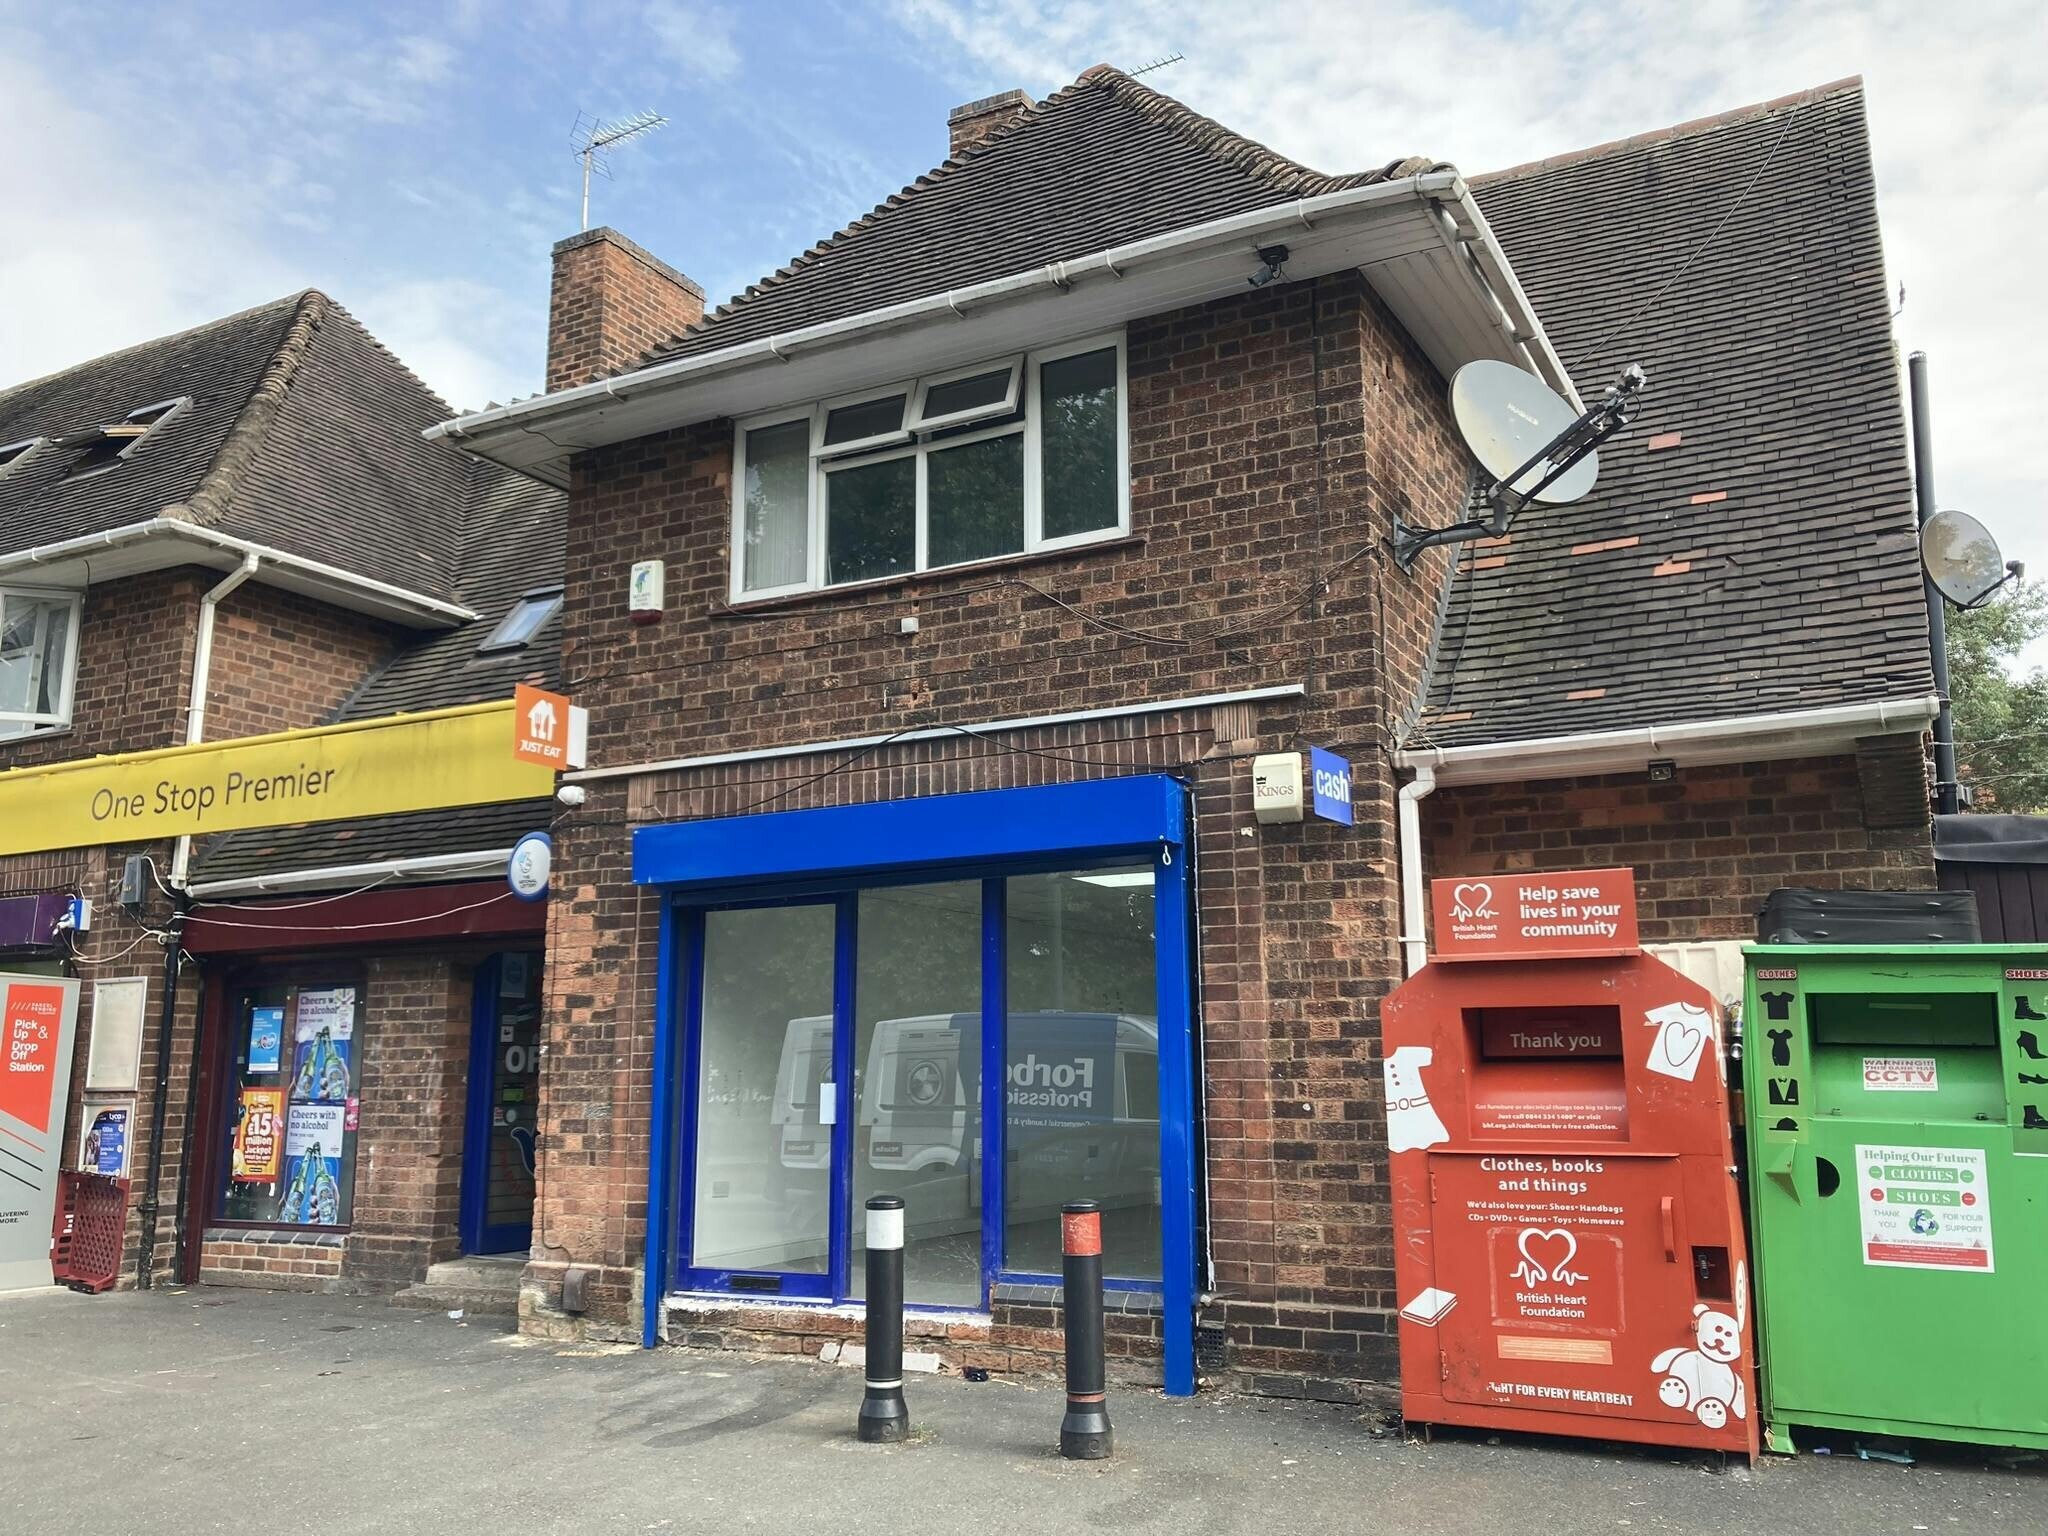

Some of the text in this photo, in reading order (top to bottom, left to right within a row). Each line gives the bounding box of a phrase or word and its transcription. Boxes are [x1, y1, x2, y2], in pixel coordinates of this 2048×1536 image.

[520, 739, 562, 759] JUST EAT
[92, 763, 335, 821] One Stop Premier
[1257, 784, 1294, 797] KINGS
[1316, 769, 1349, 803] cash
[1519, 886, 1599, 903] Help save
[1520, 903, 1621, 920] lives in your
[1452, 924, 1475, 932] British
[1521, 920, 1617, 938] community
[1455, 932, 1496, 940] Foundation
[1758, 970, 1796, 978] CLOTHES
[2006, 970, 2048, 978] SHOES
[15, 1019, 37, 1029] Pick
[14, 1026, 48, 1040] Up &
[12, 1041, 38, 1053] Drop
[1510, 1032, 1601, 1051] Thank you
[11, 1051, 28, 1060] Off
[9, 1062, 45, 1072] Station
[1865, 1070, 1934, 1082] CCTV
[291, 1110, 336, 1119] Cheers with
[247, 1113, 273, 1136] £15
[301, 1120, 328, 1130] alcohol
[245, 1136, 273, 1146] million
[1864, 1150, 1977, 1164] Helping Our Future
[1480, 1158, 1603, 1174] Clothes, books
[1891, 1169, 1954, 1180] CLOTHES
[1498, 1178, 1587, 1195] and things
[1896, 1191, 1951, 1203] SHOES
[1467, 1201, 1486, 1209] We'd
[1488, 1201, 1505, 1209] also
[1580, 1204, 1624, 1214] Handbags
[1873, 1209, 1900, 1217] THANK
[1468, 1213, 1624, 1225] CDs DVDs Games Toys Homeware
[1943, 1213, 1983, 1222] FOR YOUR
[1945, 1225, 1983, 1233] SUPPORT
[1516, 1292, 1587, 1305] British Heart
[1520, 1306, 1585, 1318] Foundation
[1516, 1384, 1535, 1396] FOR
[1538, 1386, 1571, 1400] EVERY
[1572, 1390, 1633, 1406] HEARTBEAT
